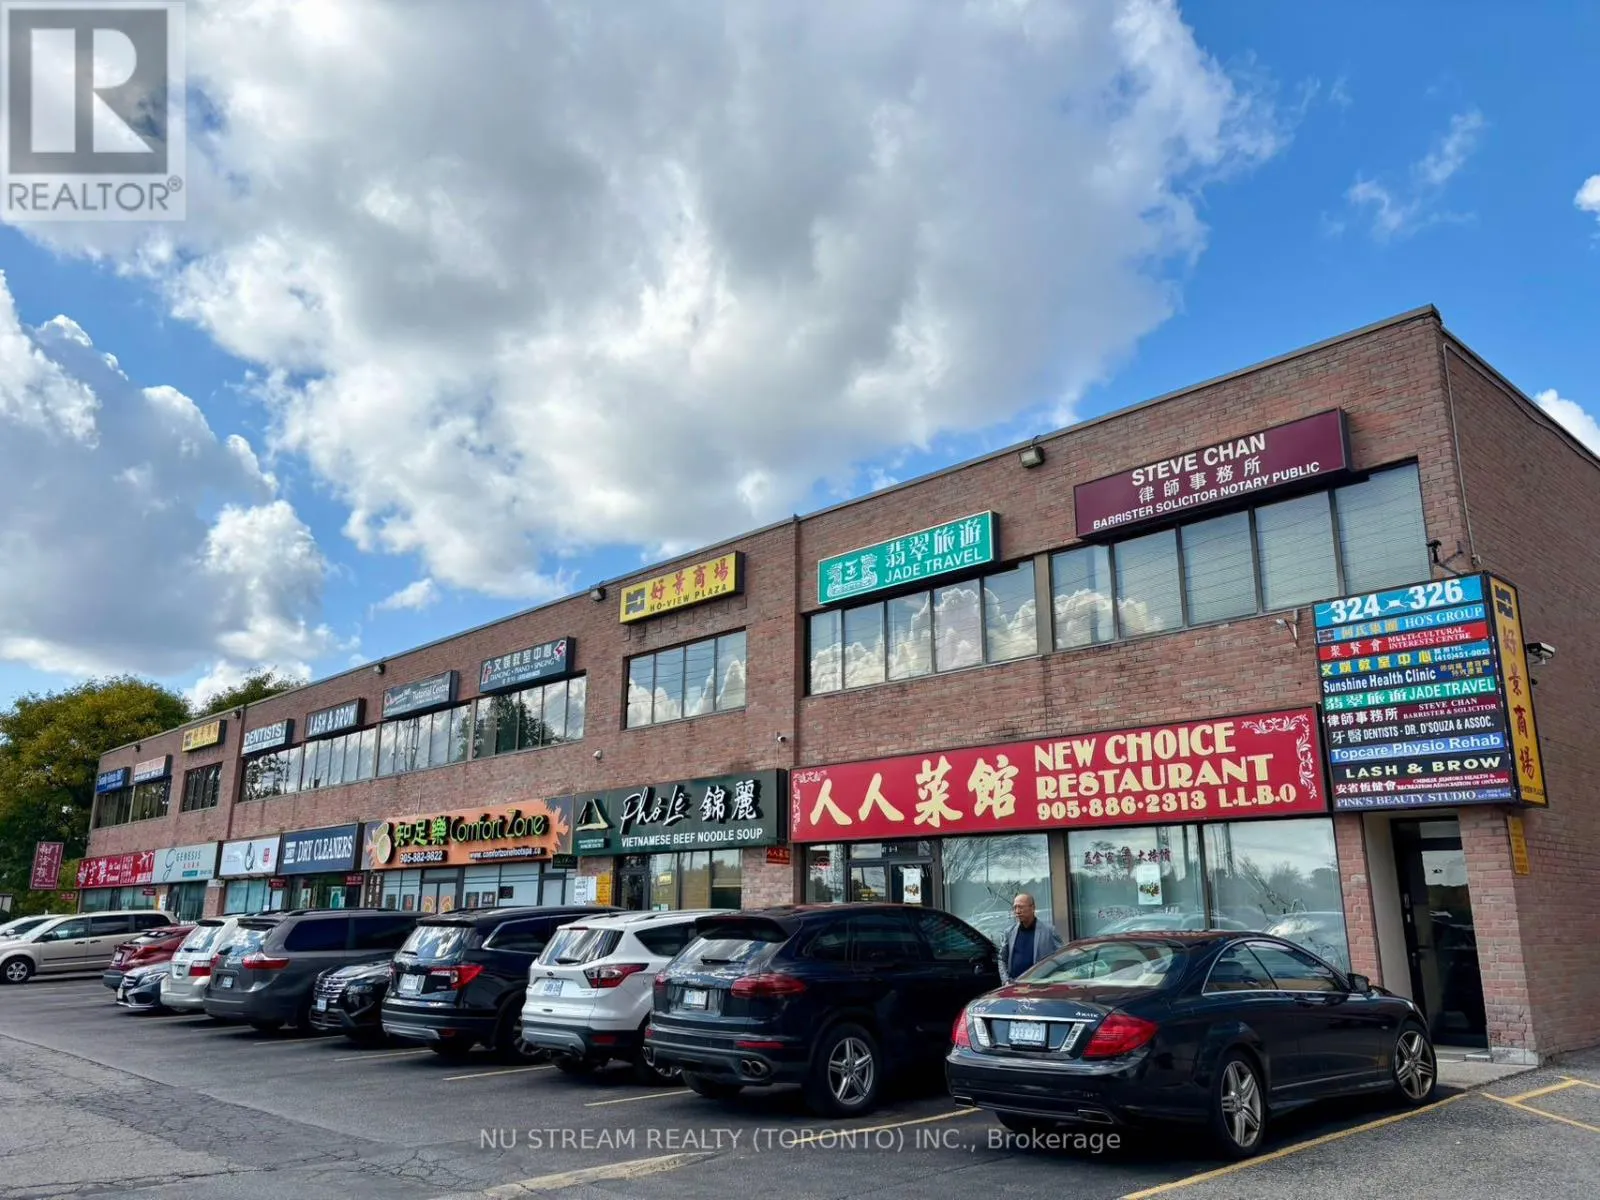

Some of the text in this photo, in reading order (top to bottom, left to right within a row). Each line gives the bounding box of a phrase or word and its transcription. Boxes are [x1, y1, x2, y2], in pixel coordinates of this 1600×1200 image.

[1132, 433, 1266, 486] STEVE CHAN
[1138, 456, 1262, 503] 律師事務所
[1093, 461, 1320, 530] BARRISTER SOLICITOR NOTARY PUBLIC
[885, 547, 983, 584] JADE TRAVEL
[650, 558, 729, 600] 好景商場
[650, 583, 727, 612] HO-VIEW PLAZA
[1331, 594, 1381, 623] 324
[1408, 579, 1463, 609] 326
[1405, 607, 1482, 629] HO'S GROUP
[1388, 627, 1464, 642] MULTI-CULTURAL
[1389, 637, 1434, 650] INTERESTS
[1436, 632, 1470, 643] CENTRE
[1323, 676, 1367, 693] Sunshine
[1370, 672, 1402, 686] Health
[1405, 668, 1436, 683] Clinic
[1408, 684, 1440, 699] JADE
[1443, 678, 1495, 697] TRAVEL
[1327, 708, 1398, 727] 律師事務所
[1403, 710, 1445, 720] BARRISTER
[1453, 703, 1496, 715] SOLICITOR
[1419, 698, 1477, 711] STEVE CHAN
[309, 704, 357, 735] LASH & BROW
[1364, 726, 1399, 740] DENTISTS
[1405, 723, 1419, 735] DR.
[1421, 720, 1455, 735] D'SOUZA
[1456, 718, 1463, 730] &
[1464, 716, 1495, 729] ASSOC.
[244, 724, 282, 746] DENTISTS
[1034, 722, 1236, 772] NEW CHOICE
[1332, 735, 1500, 761] Topcare Physio Rehab
[1035, 754, 1274, 801] RESTAURANT
[1346, 757, 1501, 779] LASH & BROW
[699, 779, 757, 822] 錦麗
[810, 753, 1020, 829] 人人菜館
[1336, 794, 1374, 807] PINK'S
[1378, 792, 1425, 804] BEAUTY
[1428, 790, 1476, 802] STUDIO
[450, 808, 545, 842] Comfort Zone
[622, 827, 763, 848] VIETNAMESE BEEF NOODLE SOUP
[297, 840, 314, 862] DRY
[314, 835, 353, 861] CLEANERS
